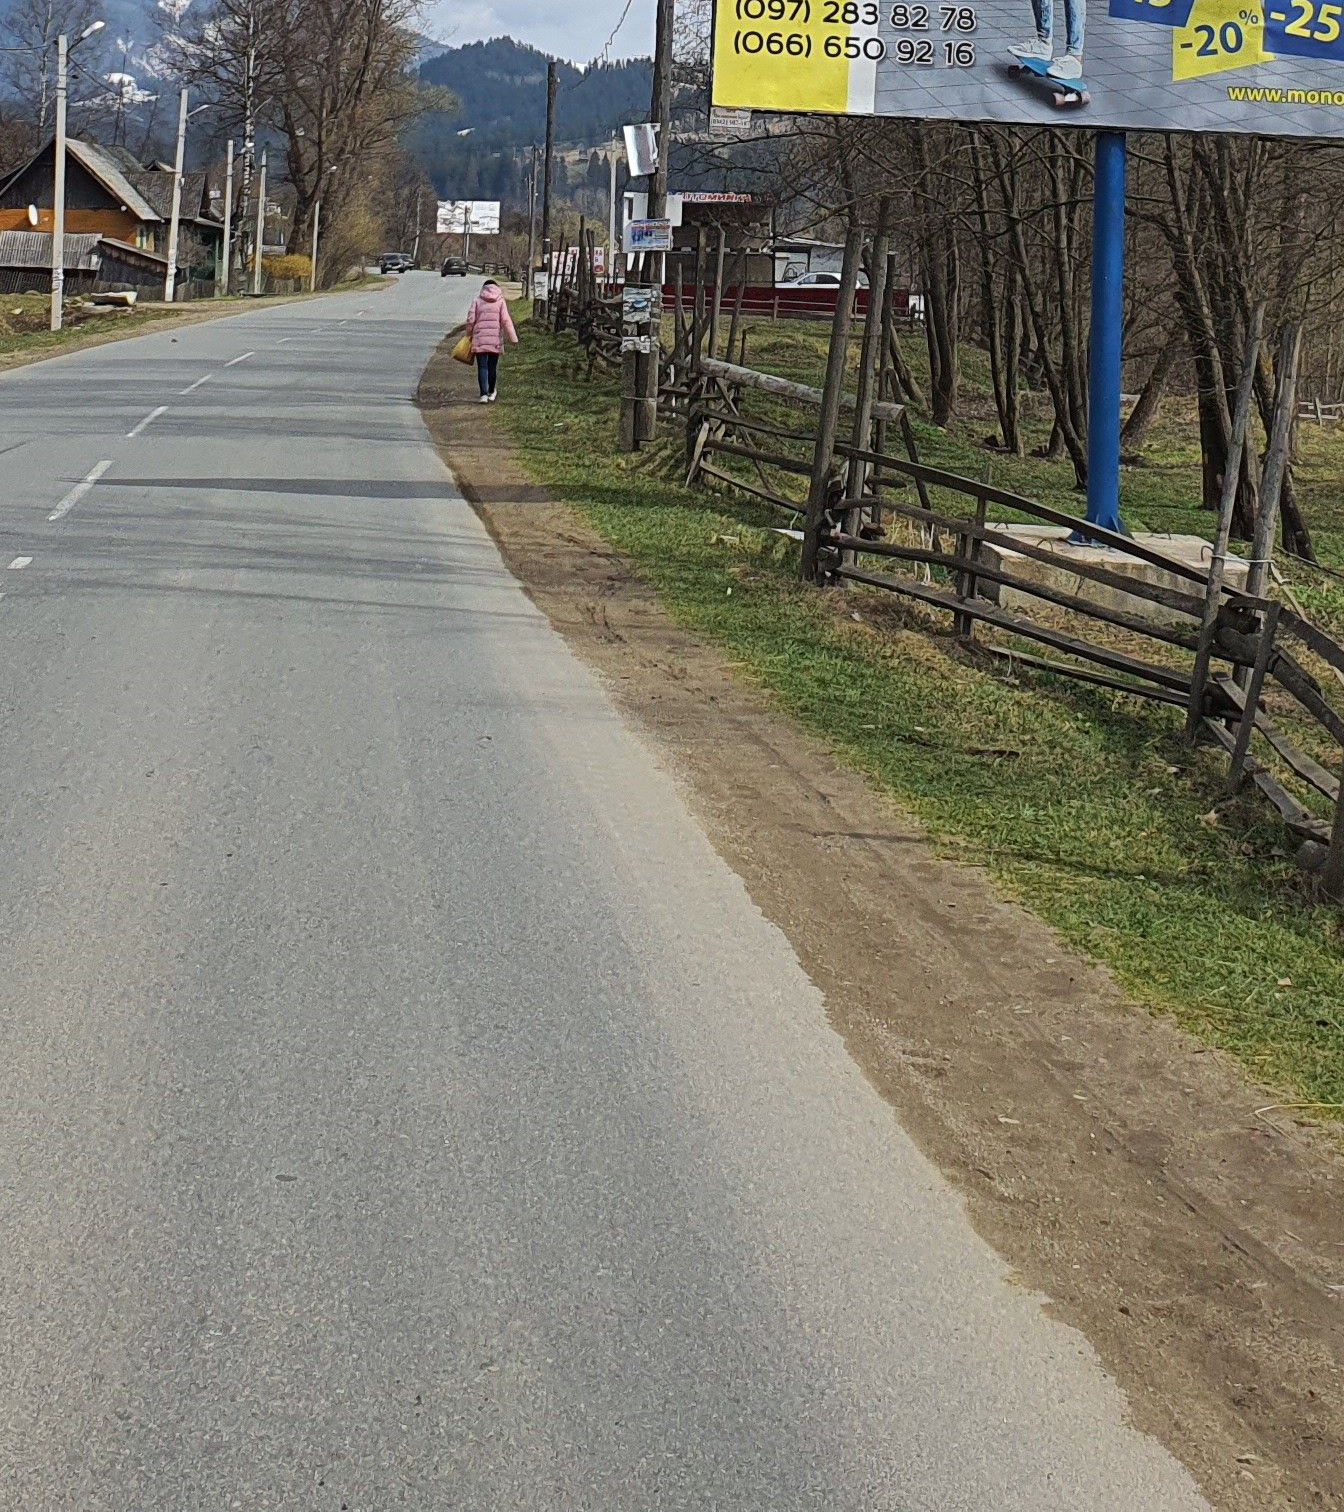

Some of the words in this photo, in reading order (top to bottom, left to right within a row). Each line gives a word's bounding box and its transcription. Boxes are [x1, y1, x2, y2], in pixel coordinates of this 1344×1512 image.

[822, 0, 878, 25] 283
[890, 3, 929, 29] 82
[939, 6, 976, 31] 78
[734, 30, 812, 58] (066)
[823, 35, 885, 61] 650
[896, 38, 934, 64] 92
[944, 41, 975, 66] 16
